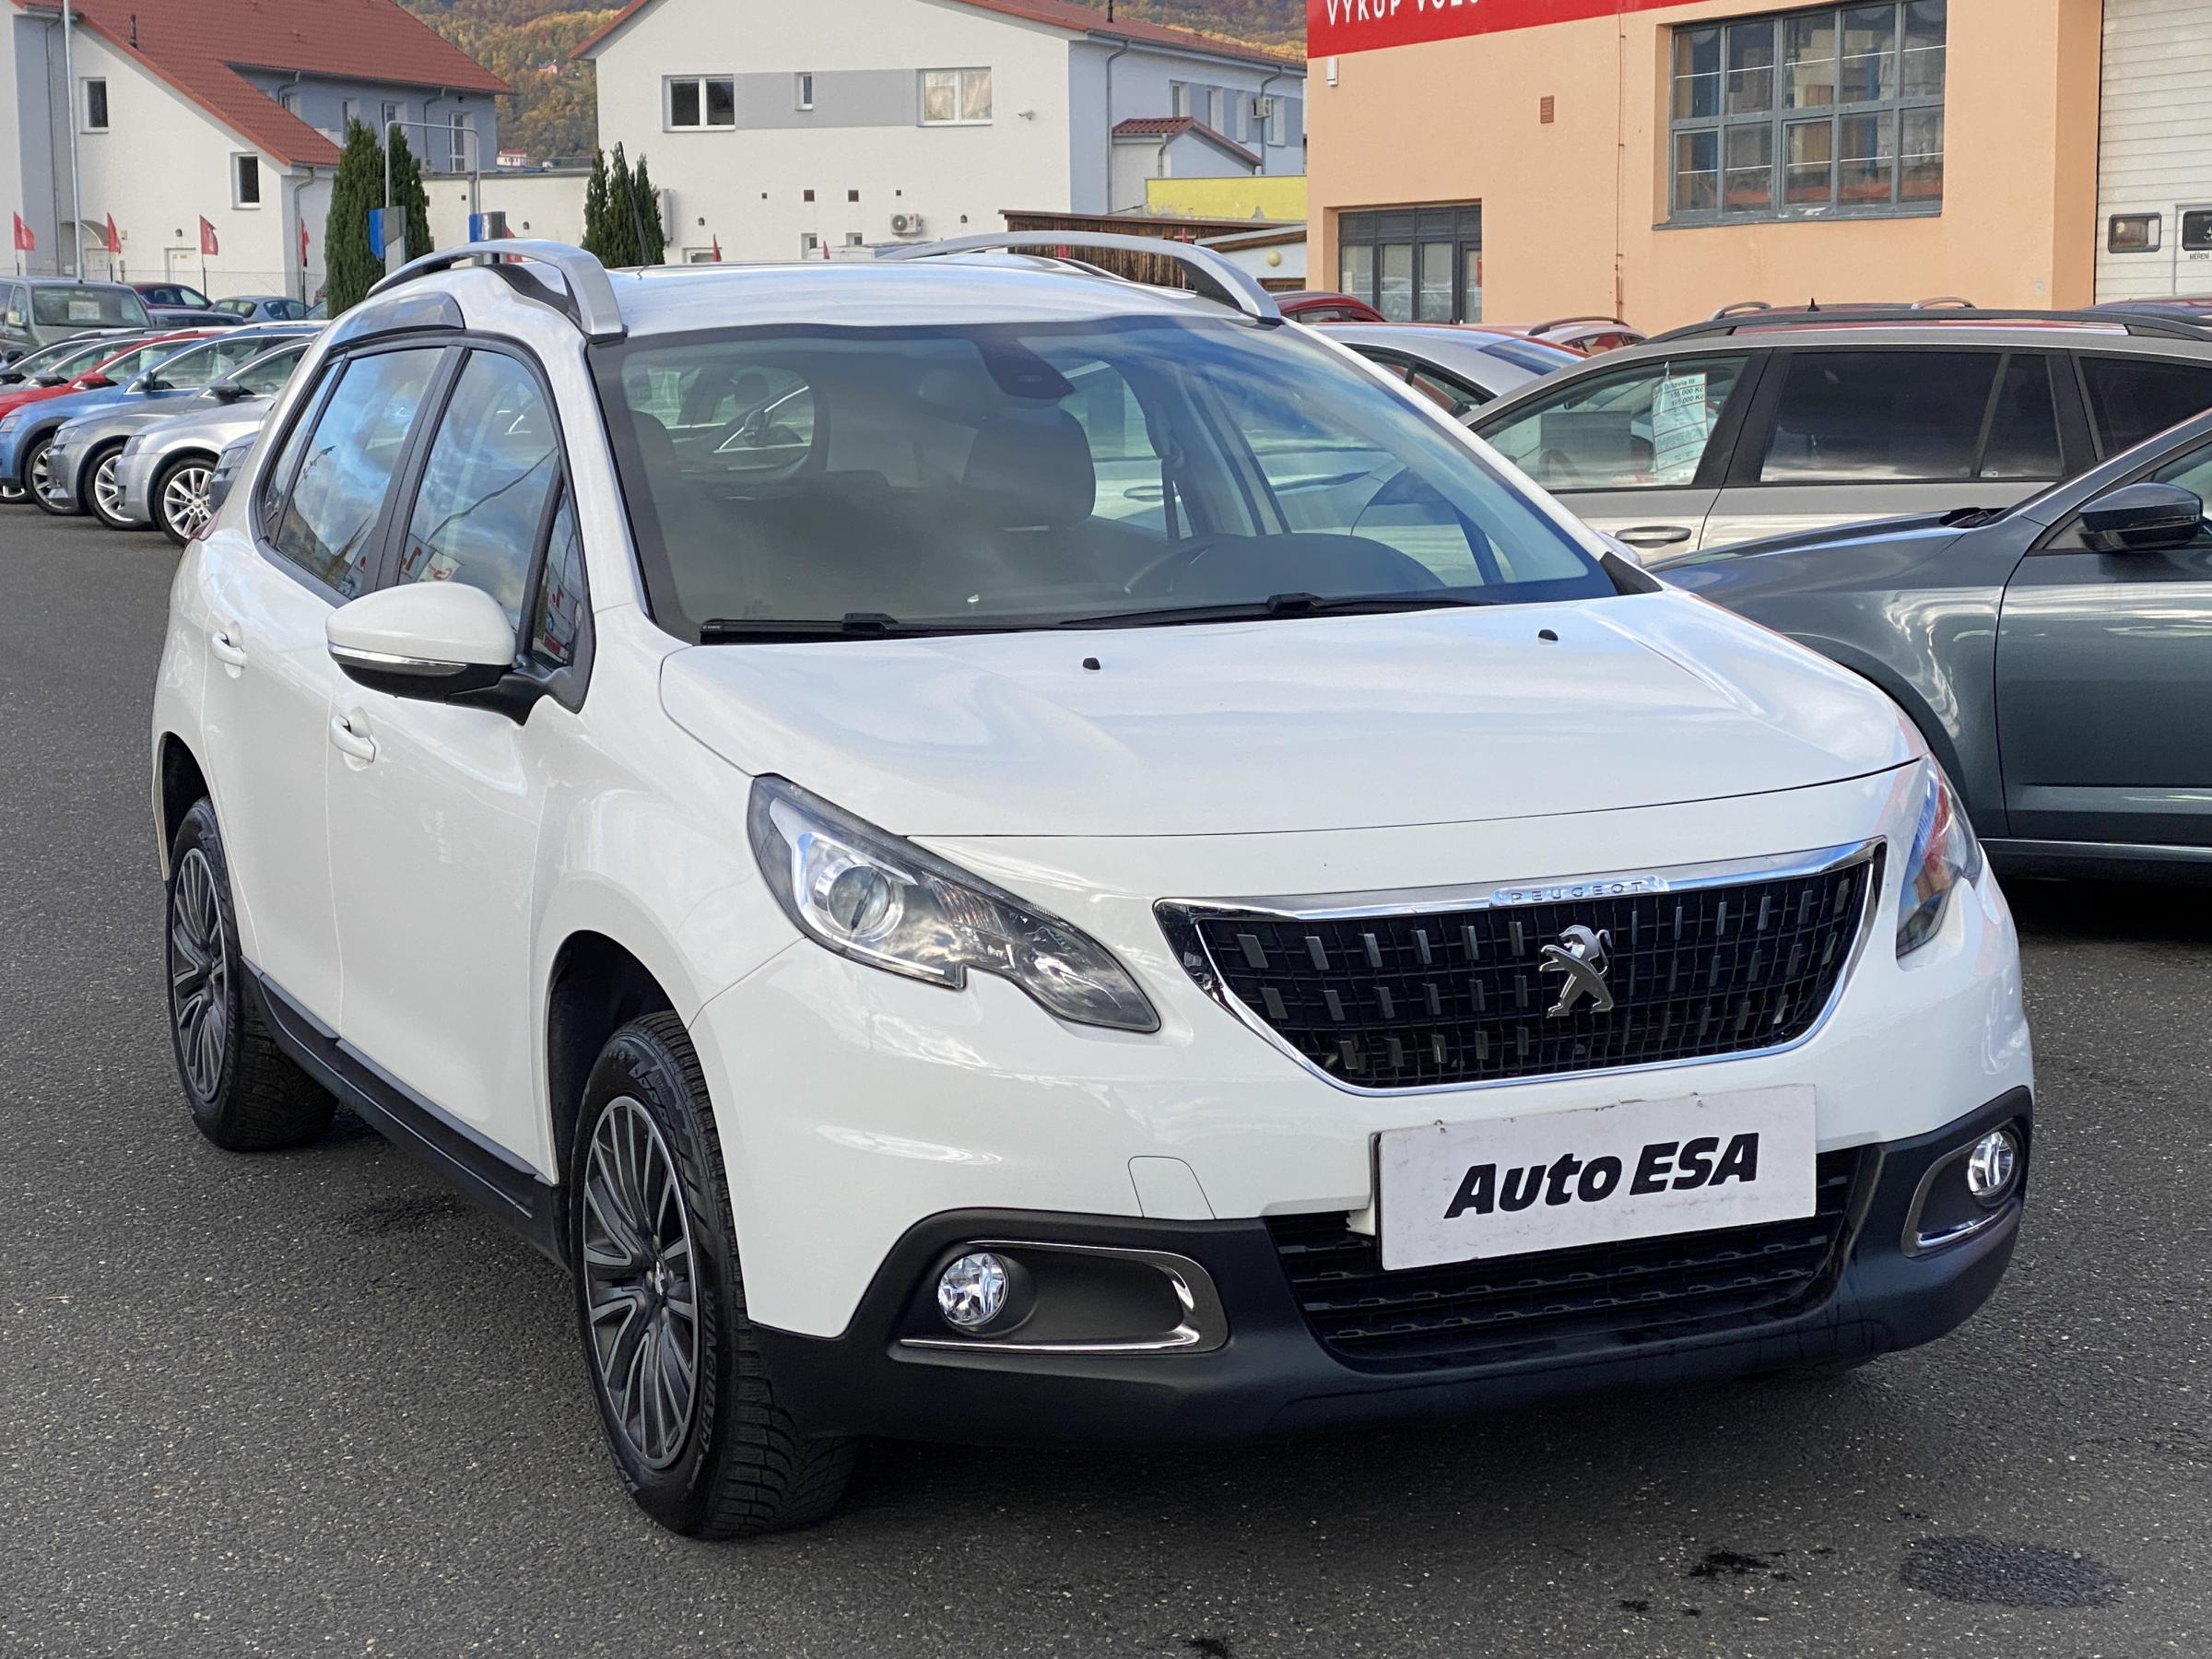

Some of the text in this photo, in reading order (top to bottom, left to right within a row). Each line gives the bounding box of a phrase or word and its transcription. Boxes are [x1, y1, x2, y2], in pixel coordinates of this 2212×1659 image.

[1511, 881, 1644, 903] PEUGEOT
[1443, 1133, 1759, 1219] Auto ESA
